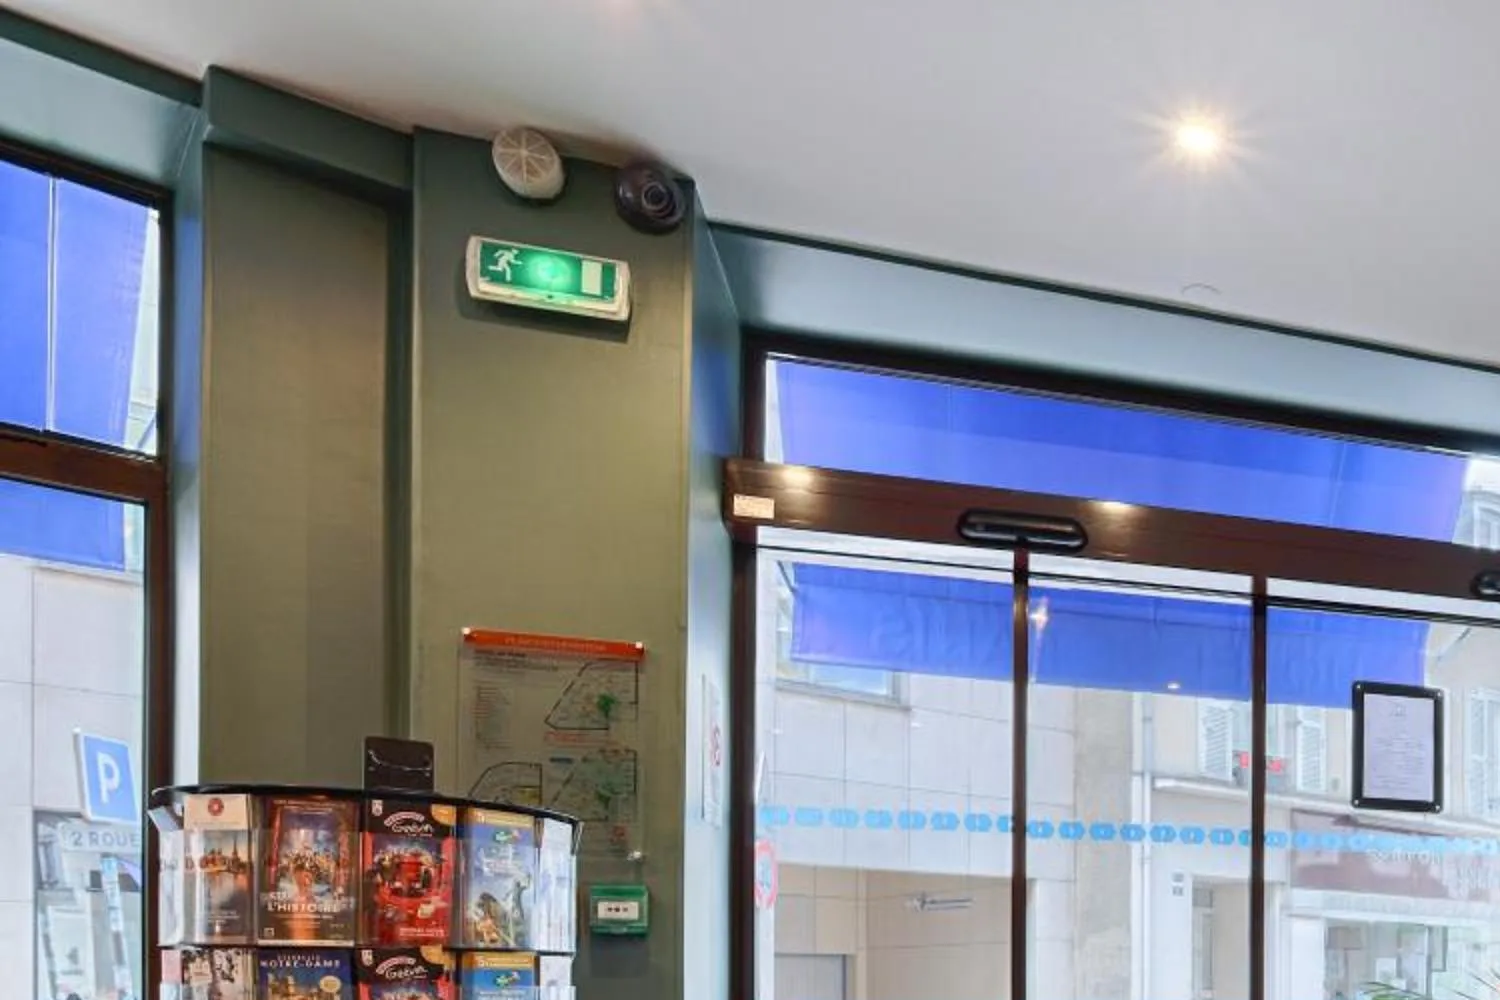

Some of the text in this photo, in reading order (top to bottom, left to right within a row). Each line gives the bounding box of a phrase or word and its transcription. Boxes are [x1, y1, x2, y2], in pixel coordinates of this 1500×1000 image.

[96, 751, 121, 804] P
[71, 830, 141, 848] 2 ROUE
